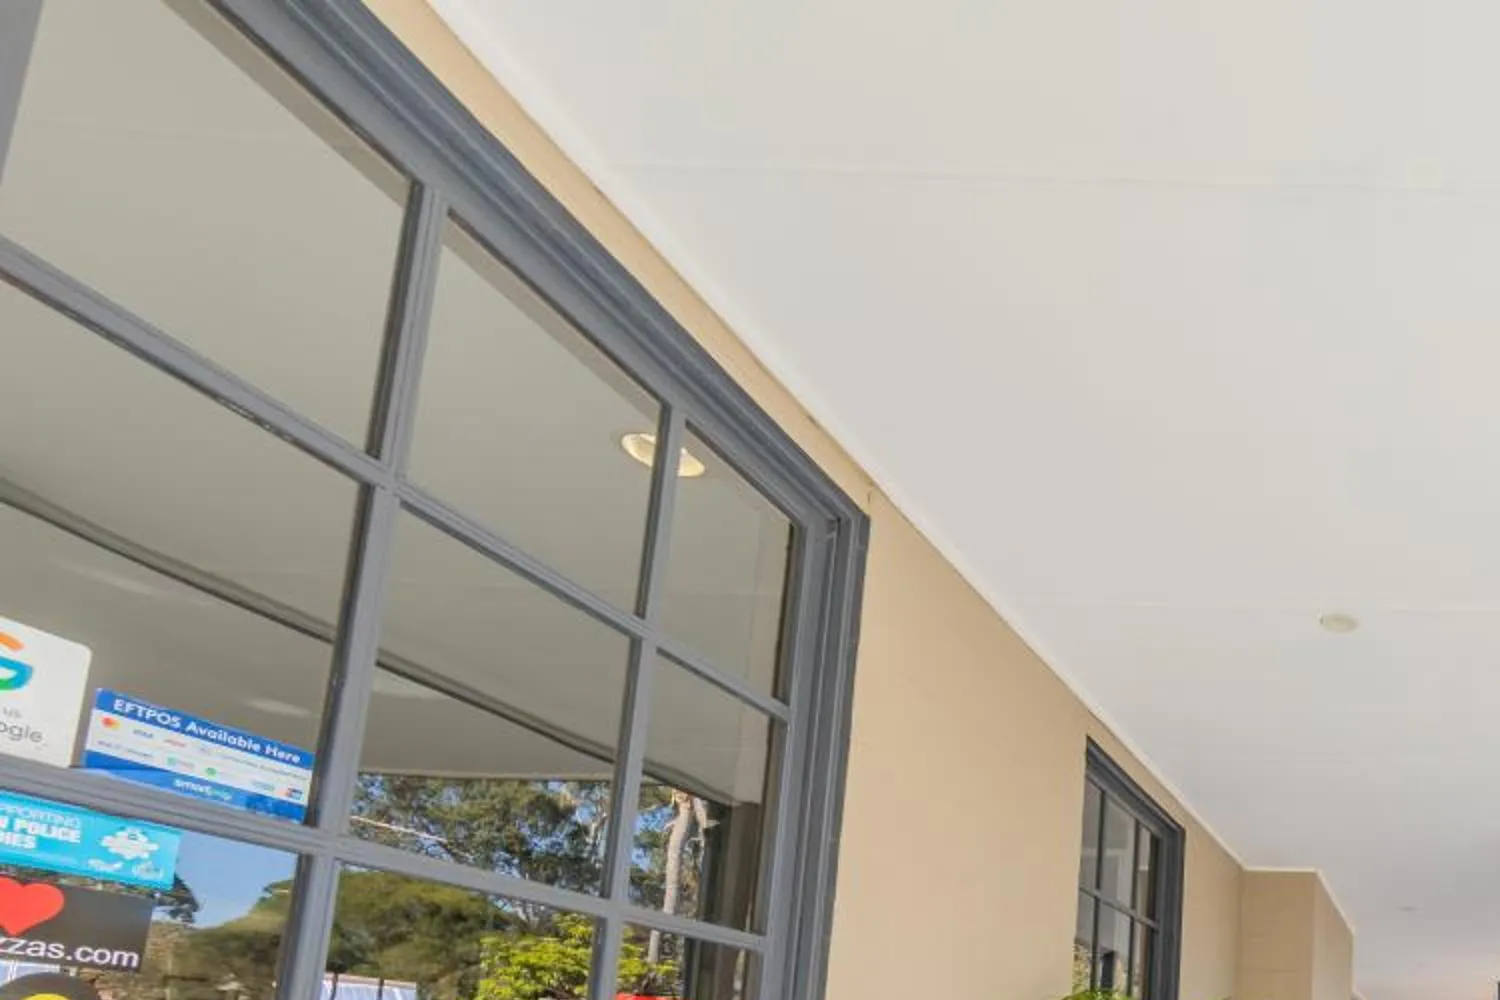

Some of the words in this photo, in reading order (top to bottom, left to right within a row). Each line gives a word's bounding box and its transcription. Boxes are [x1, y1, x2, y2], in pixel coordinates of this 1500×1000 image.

[113, 699, 182, 729] EFTPOS
[185, 720, 261, 753] Available
[265, 744, 301, 764] Here
[14, 817, 81, 843] POLICE
